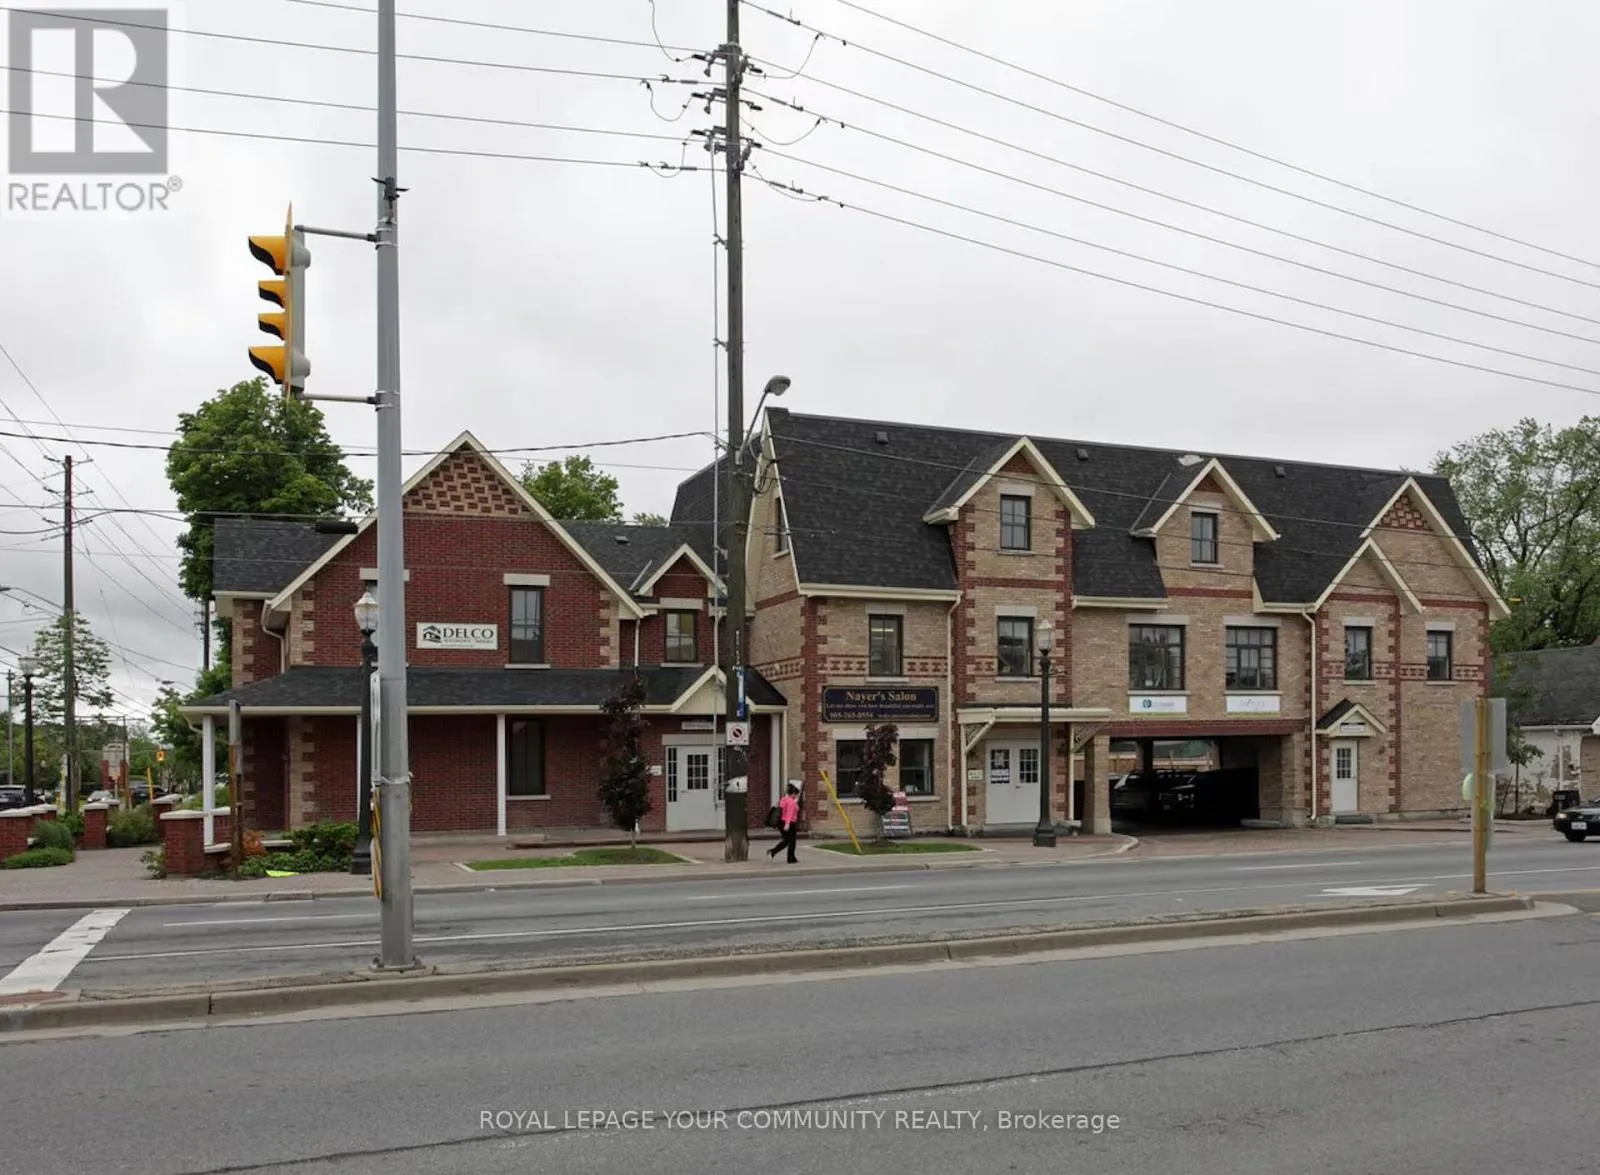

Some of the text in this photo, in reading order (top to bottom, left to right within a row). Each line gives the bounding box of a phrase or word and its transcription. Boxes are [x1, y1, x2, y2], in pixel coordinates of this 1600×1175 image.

[443, 627, 494, 639] DELCO
[846, 691, 917, 704] Nayer's Salon
